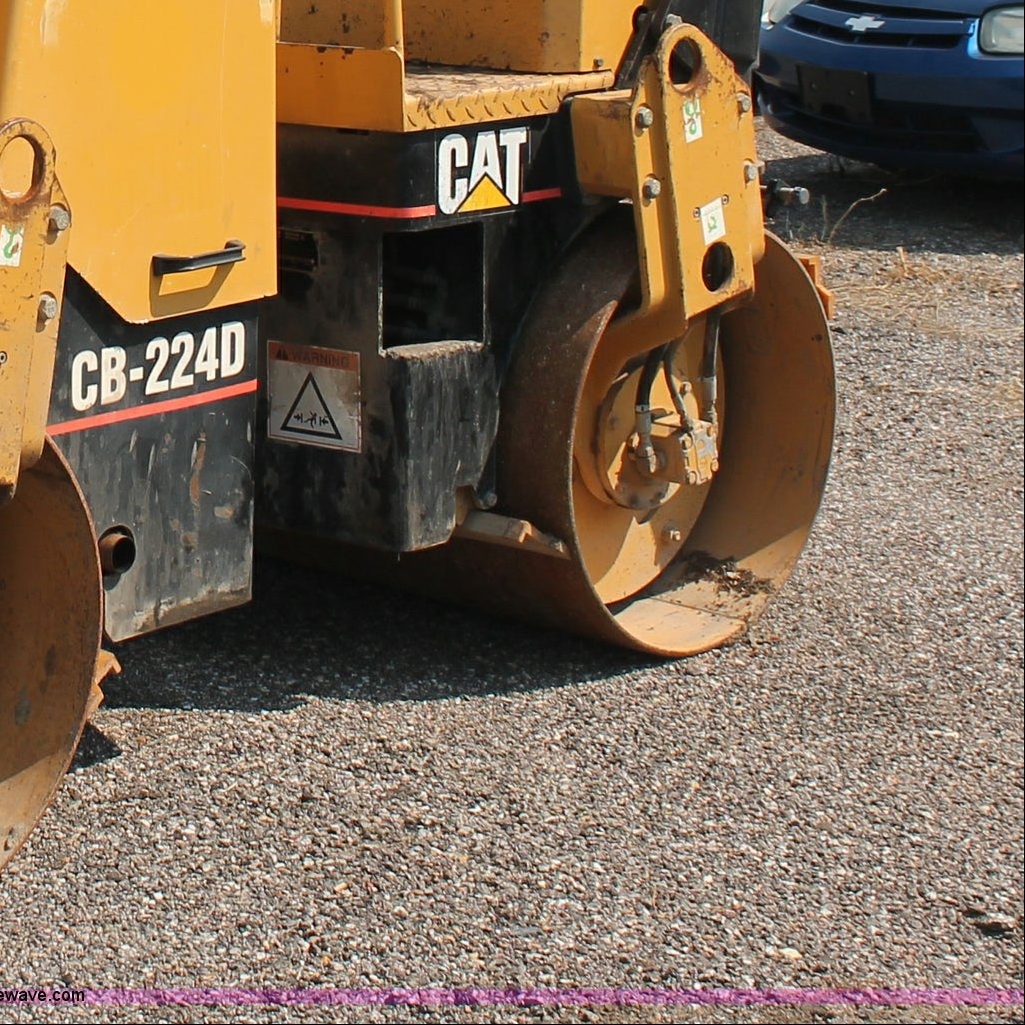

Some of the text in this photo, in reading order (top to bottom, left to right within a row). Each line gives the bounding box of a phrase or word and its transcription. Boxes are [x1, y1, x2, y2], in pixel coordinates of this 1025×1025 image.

[438, 127, 527, 215] CAT
[71, 321, 246, 411] CB-224D
[292, 348, 350, 368] WARNING
